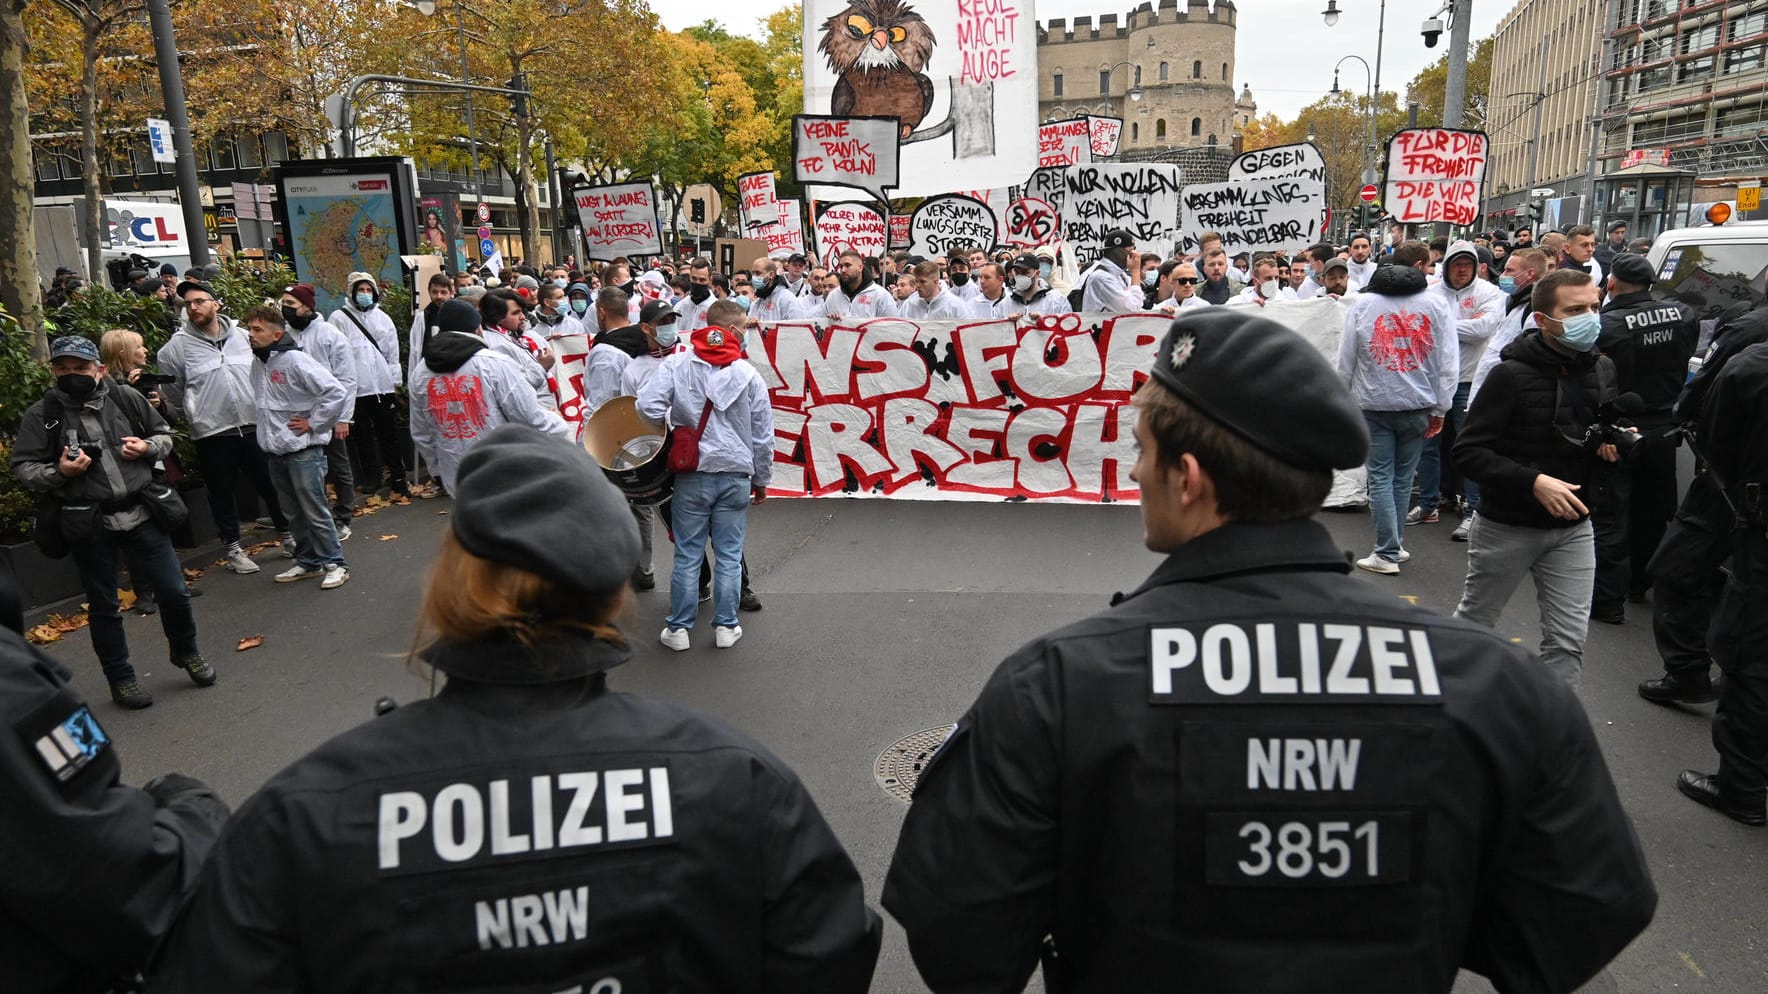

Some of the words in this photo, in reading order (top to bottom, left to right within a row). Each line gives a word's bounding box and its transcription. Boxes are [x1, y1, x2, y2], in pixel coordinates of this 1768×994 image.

[957, 13, 1019, 51] MACHT
[961, 49, 1016, 86] AUGE
[1397, 129, 1449, 154] FÜR
[1451, 132, 1483, 155] DIE
[799, 157, 823, 173] FC
[833, 152, 875, 175] KÖLN!
[1240, 149, 1305, 173] GEGEN
[1402, 154, 1484, 179] FREIHEIT
[1067, 168, 1105, 194] WIR
[1104, 167, 1179, 194] WOLLEN
[1395, 181, 1434, 199] DIE
[1440, 181, 1476, 203] WIR
[576, 195, 601, 208] LUST
[603, 194, 613, 207] &
[612, 190, 648, 207] LAUNE
[1075, 198, 1149, 219] KEINEN
[594, 209, 626, 223] STATT
[1198, 209, 1268, 229] FREIHEIT
[1402, 199, 1475, 224] LIEBEN
[584, 225, 602, 238] LAW
[604, 223, 612, 237] &
[611, 220, 654, 239] ORDER!
[818, 223, 842, 233] MEHR
[916, 217, 993, 240] LUNGSGESETZ
[1625, 307, 1682, 330] POLIZEI
[1643, 328, 1673, 346] NRW
[1151, 623, 1441, 695] POLIZEI
[1247, 738, 1361, 790] NRW
[379, 767, 673, 869] POLIZEI
[1238, 820, 1378, 878] 3851
[475, 886, 589, 950] NRW
